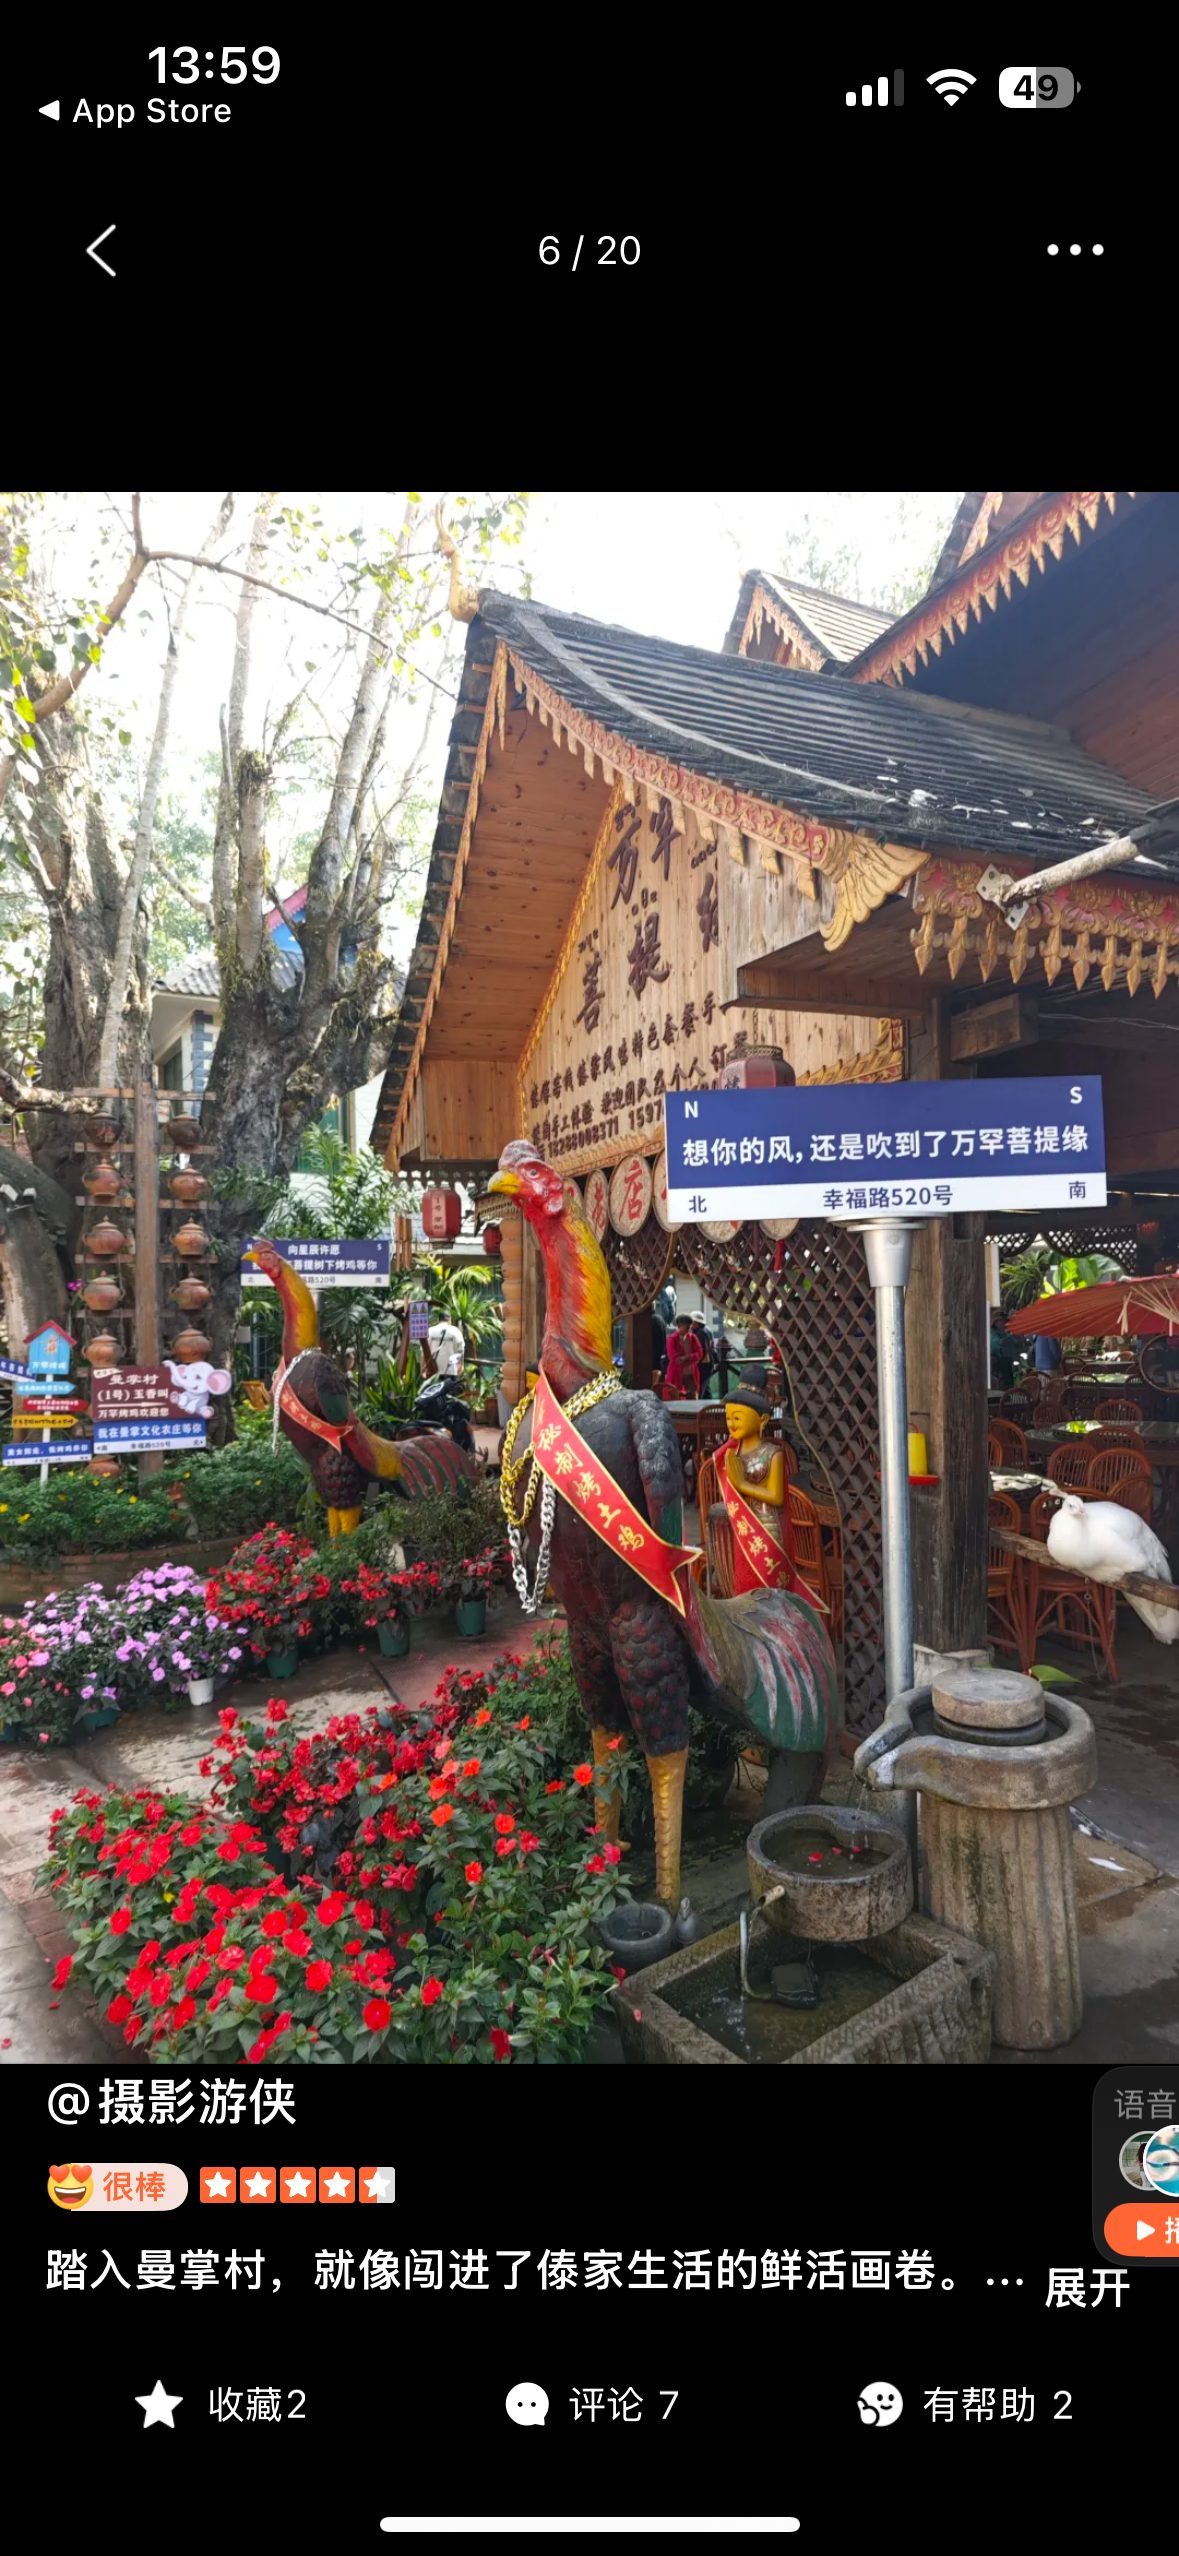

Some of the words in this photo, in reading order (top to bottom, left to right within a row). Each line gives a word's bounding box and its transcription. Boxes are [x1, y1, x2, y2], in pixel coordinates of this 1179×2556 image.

[627, 1100, 665, 1130] 1597
[684, 1101, 699, 1118] N
[1070, 1086, 1083, 1104] S
[683, 1125, 1089, 1167] 想你的风，还是吹到了万罕菩提缘
[689, 1195, 707, 1214] 北
[822, 1184, 954, 1210] 幸福路520号
[1068, 1181, 1087, 1199] 南
[537, 1423, 645, 1551] 秘制烤土鸡
